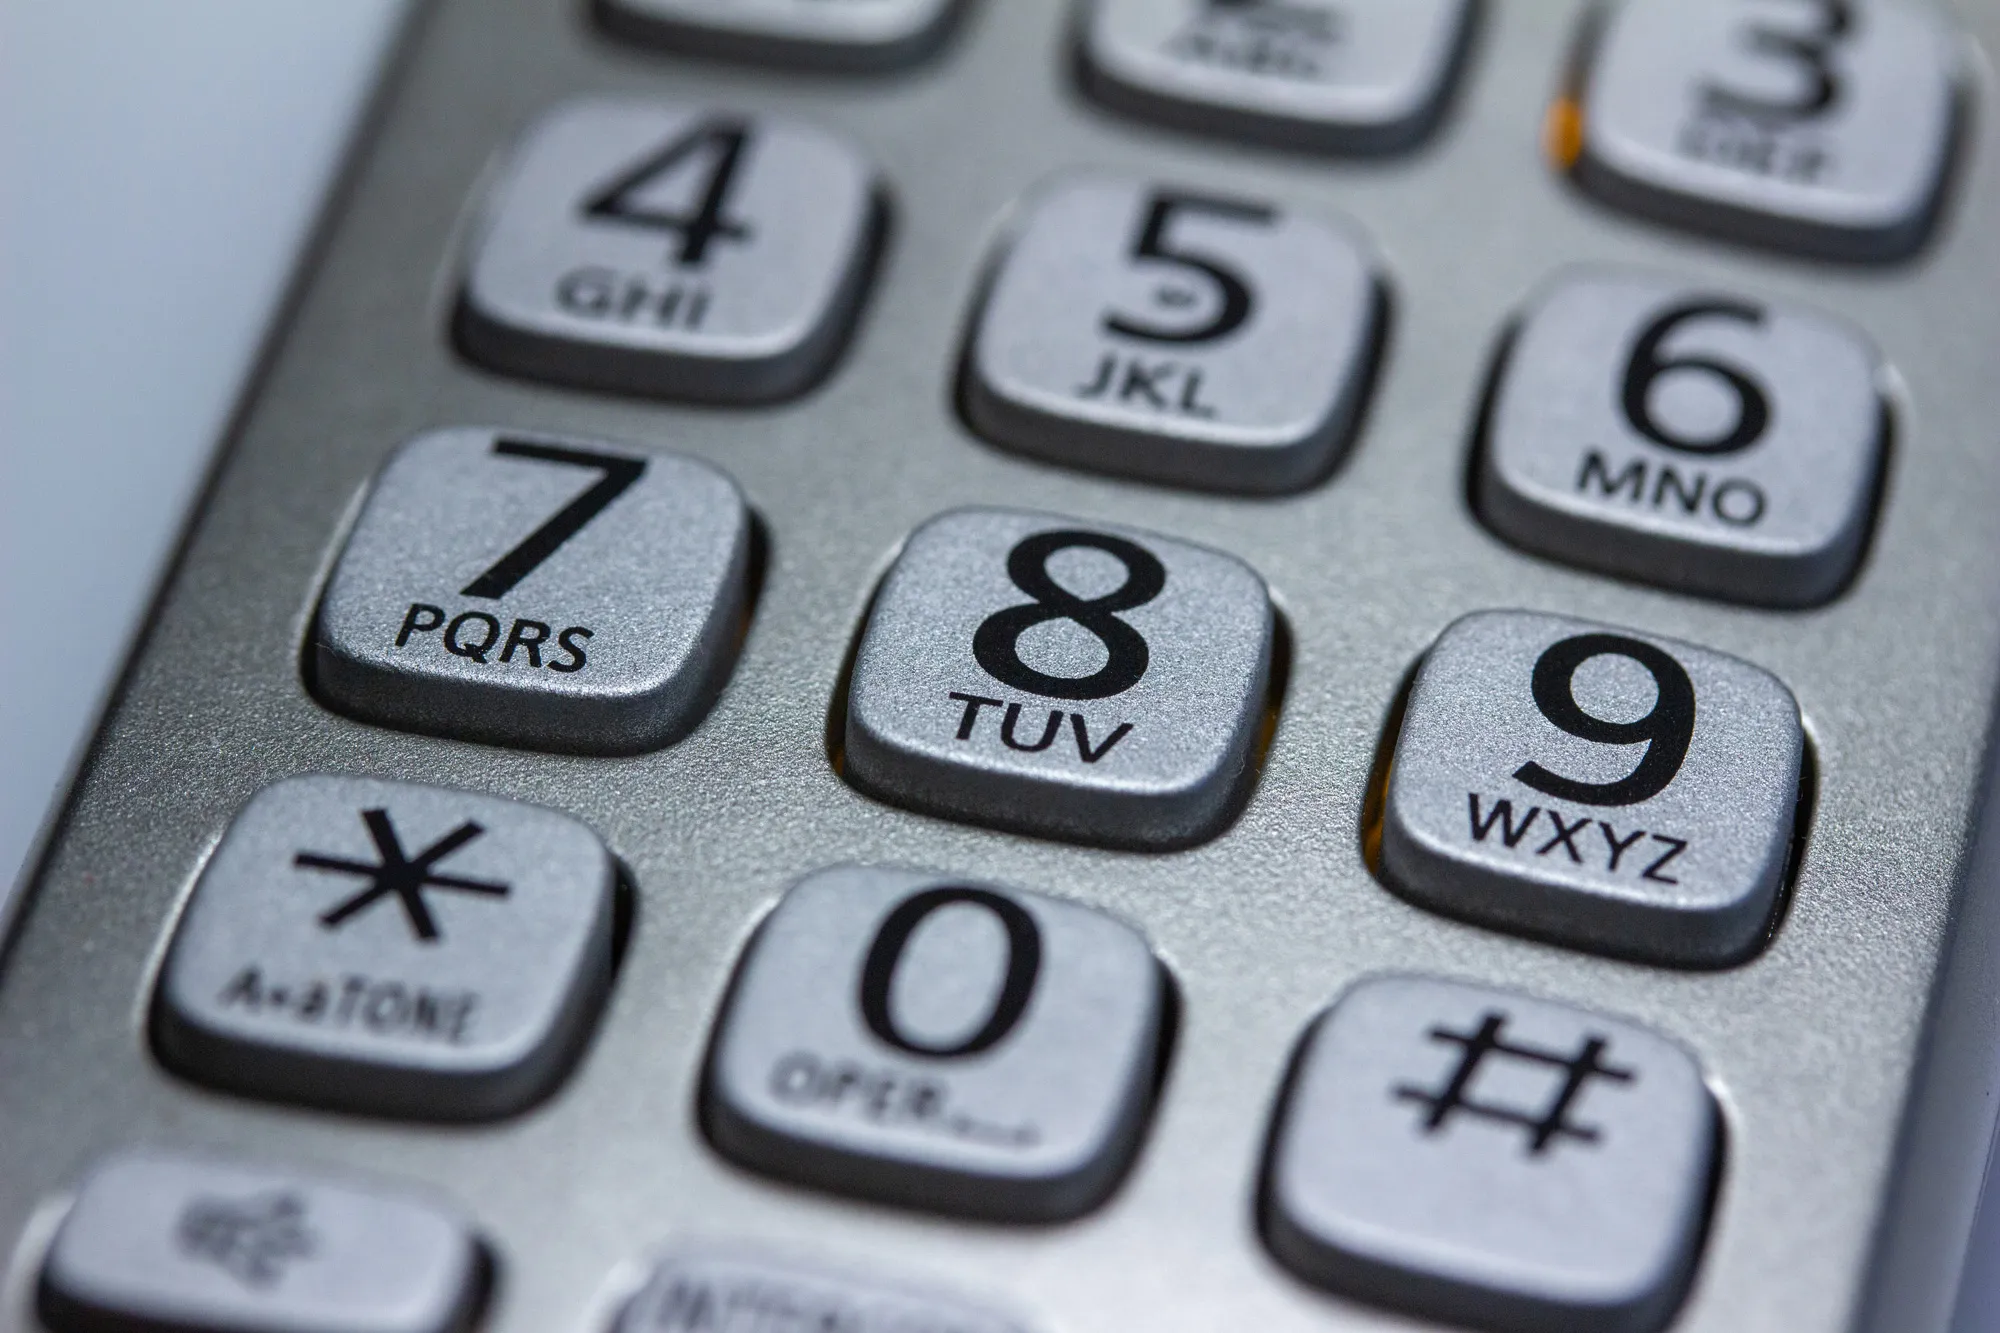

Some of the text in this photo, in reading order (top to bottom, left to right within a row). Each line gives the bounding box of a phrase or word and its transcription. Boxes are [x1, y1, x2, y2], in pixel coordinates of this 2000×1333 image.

[1694, 0, 1862, 122] 3
[578, 113, 756, 268] 4
[553, 268, 714, 330] GHI
[1101, 186, 1279, 348] 5
[1072, 354, 1217, 418] JKL
[1616, 294, 1774, 460] 6
[458, 435, 650, 601] 7
[1575, 447, 1768, 528] MNO
[394, 602, 596, 674] PQRS
[971, 527, 1167, 701] 8
[948, 690, 1135, 764] TUV
[1511, 632, 1697, 808] 9
[1468, 791, 1689, 886] WXYZ
[855, 880, 1045, 1065] 0
[1394, 1010, 1636, 1158] #
